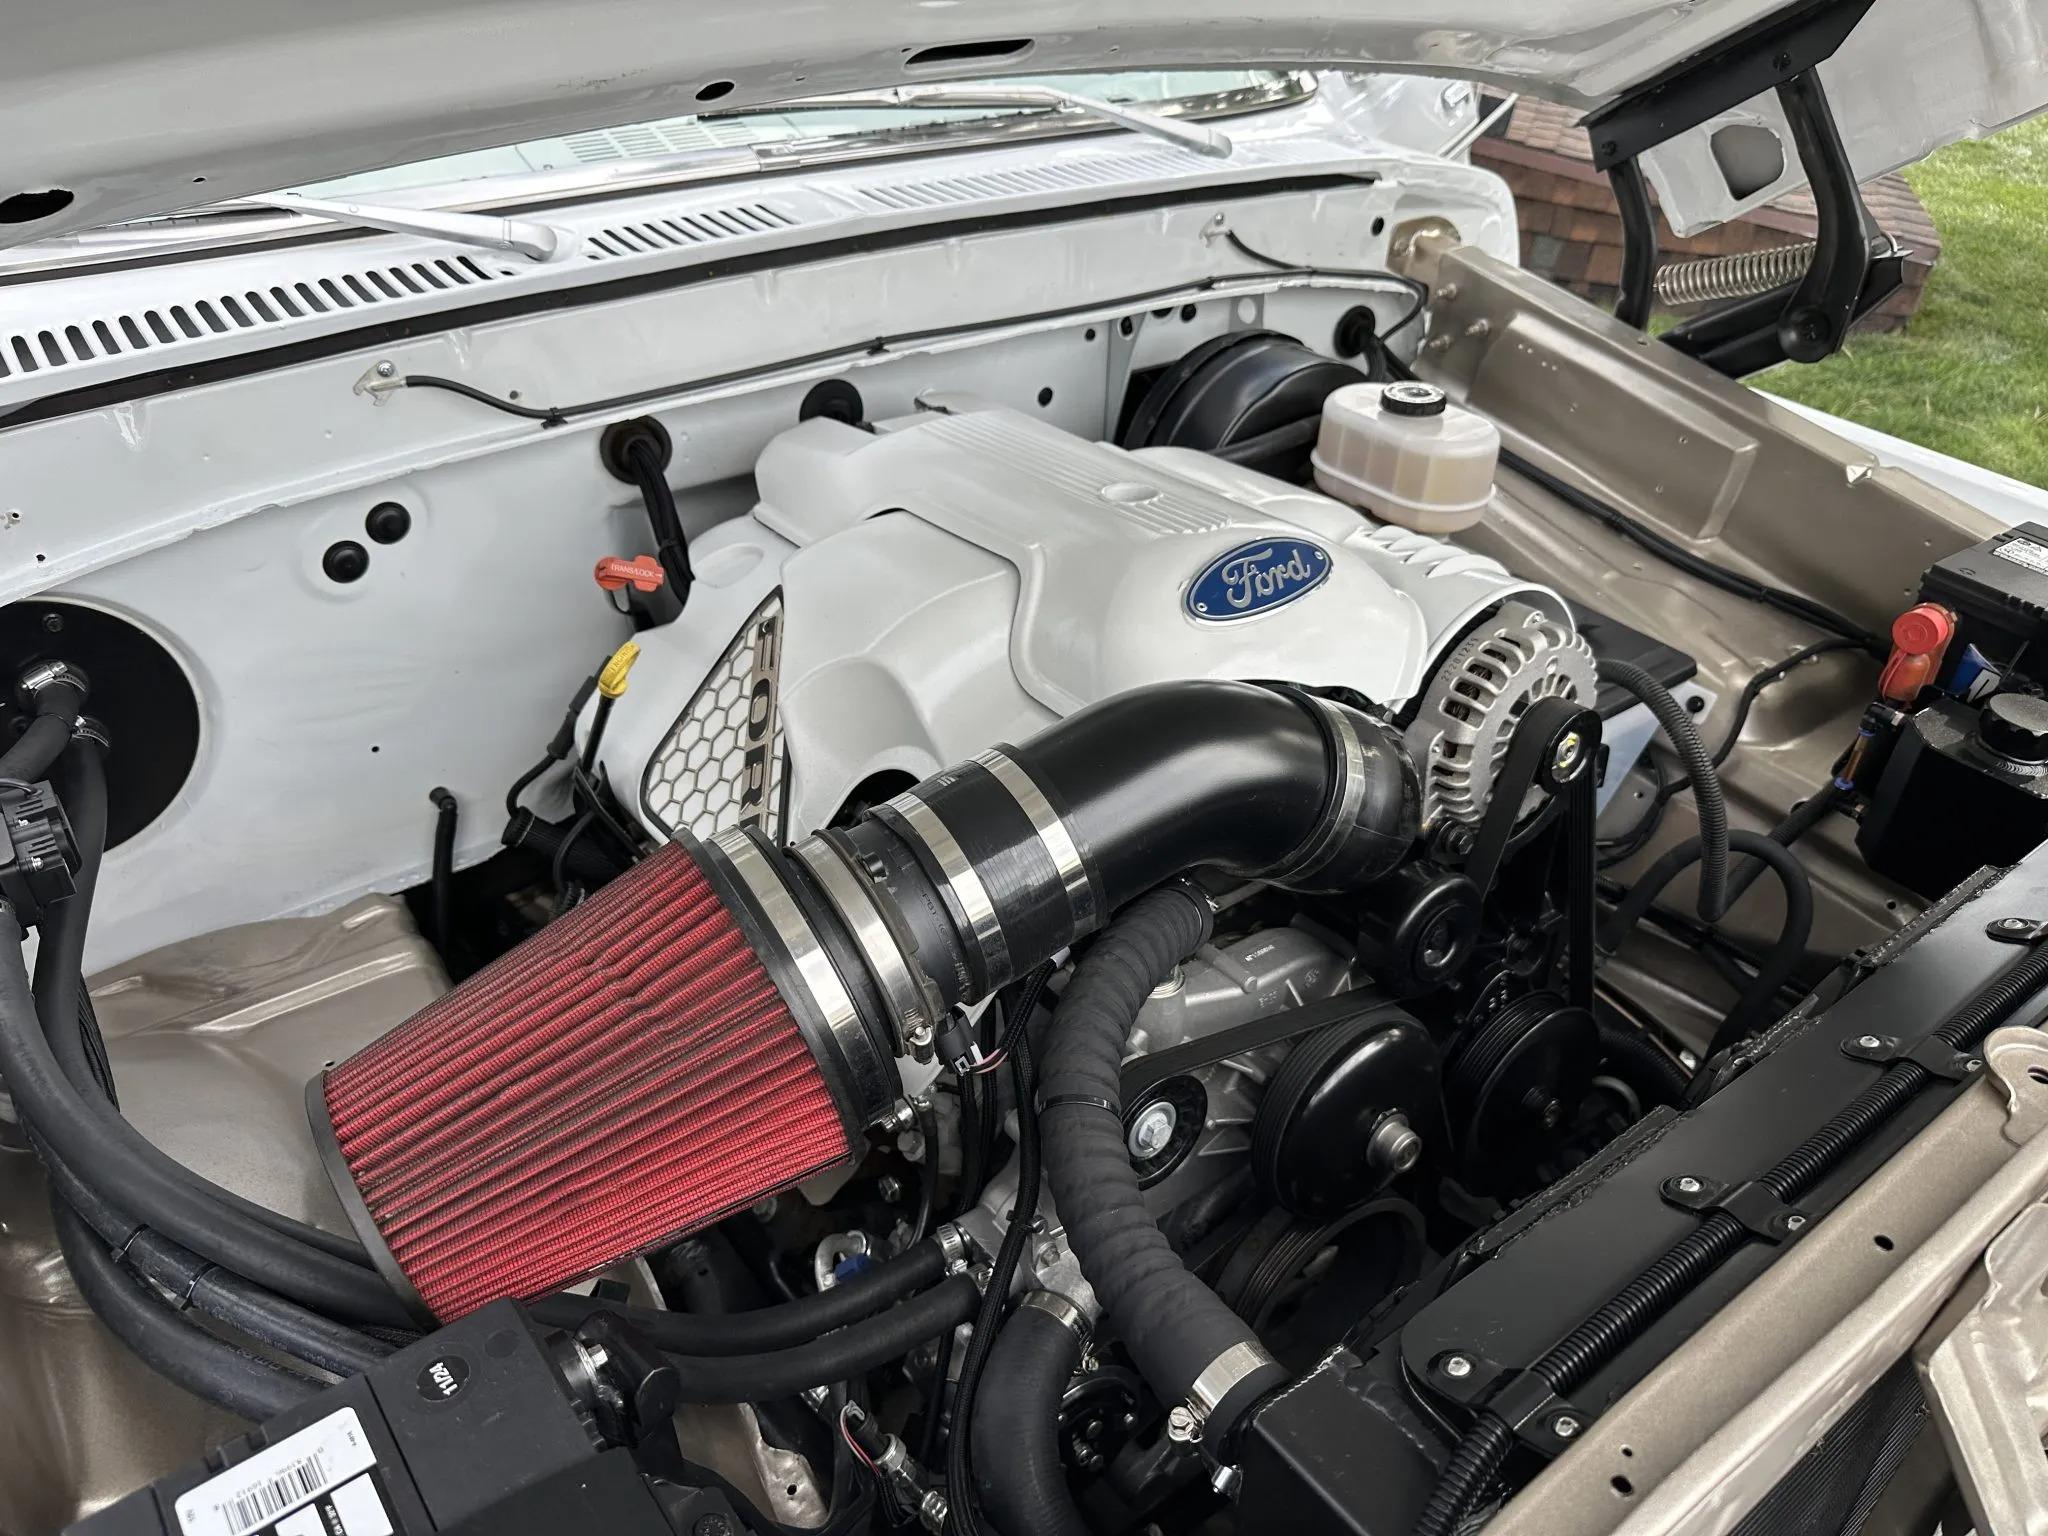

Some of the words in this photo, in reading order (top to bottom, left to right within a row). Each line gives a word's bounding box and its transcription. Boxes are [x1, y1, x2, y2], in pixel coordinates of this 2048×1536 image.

[1221, 547, 1311, 609] Ford
[740, 616, 778, 830] FOR
[429, 1362, 457, 1396] 11/24
